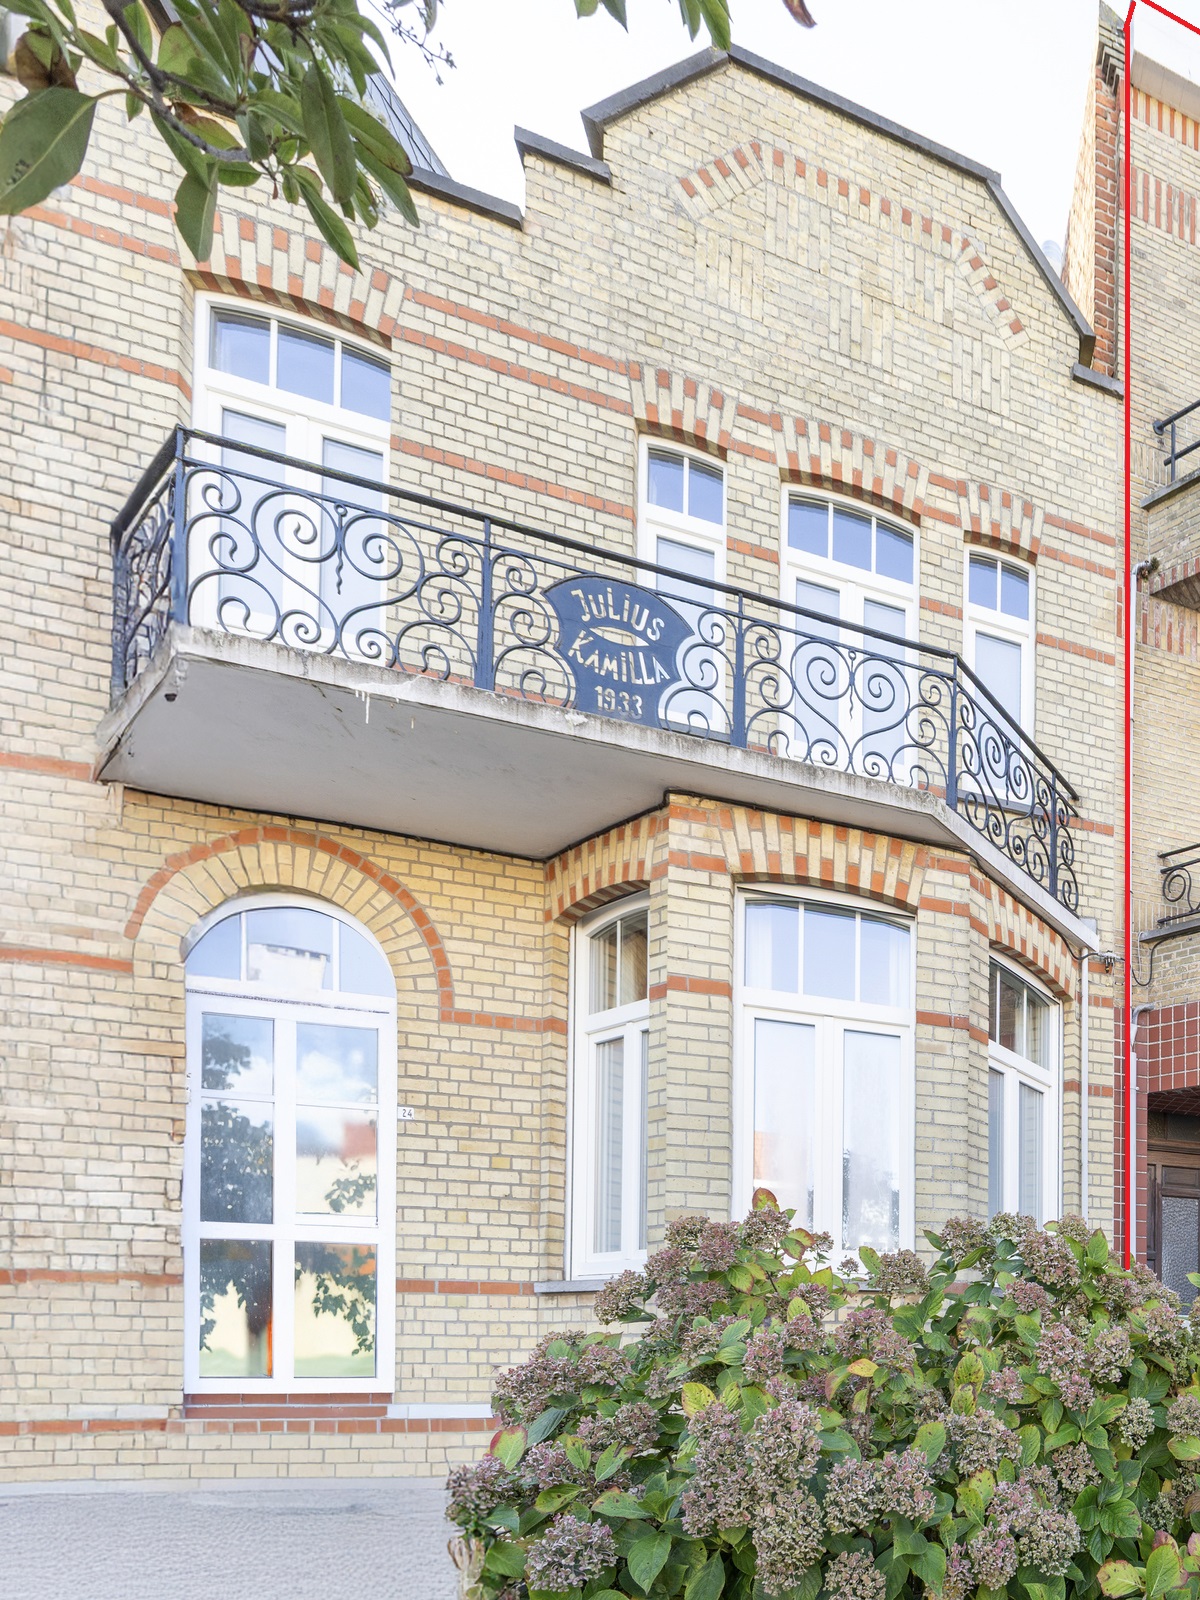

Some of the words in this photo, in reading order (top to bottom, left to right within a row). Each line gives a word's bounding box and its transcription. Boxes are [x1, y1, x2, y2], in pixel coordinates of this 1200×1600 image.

[570, 587, 665, 641] JULIUS
[568, 630, 671, 685] KAMILLA
[594, 685, 643, 719] 1933
[402, 1108, 412, 1118] 24
